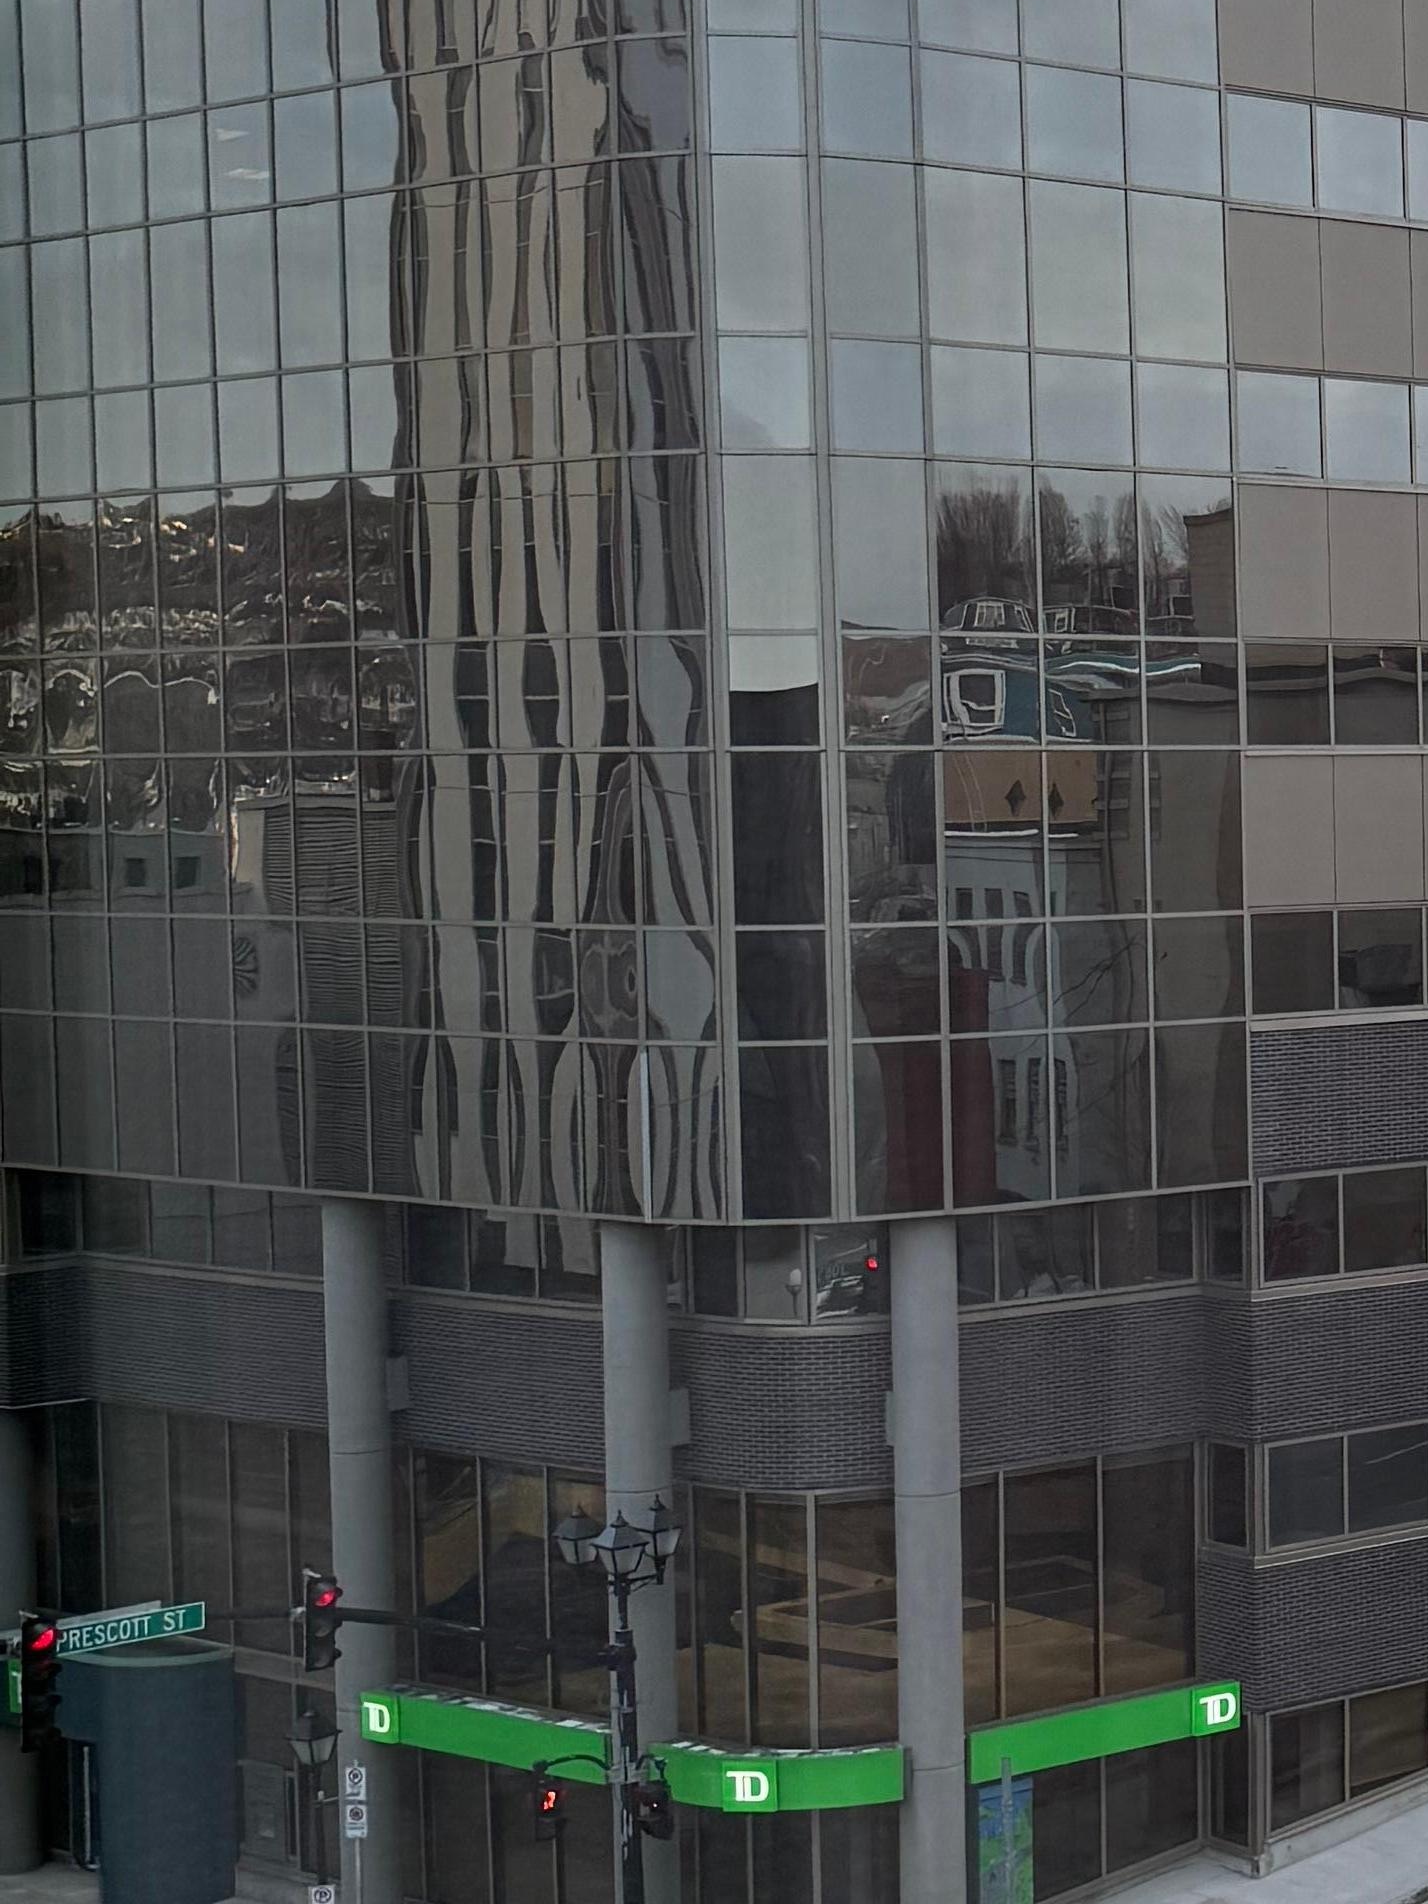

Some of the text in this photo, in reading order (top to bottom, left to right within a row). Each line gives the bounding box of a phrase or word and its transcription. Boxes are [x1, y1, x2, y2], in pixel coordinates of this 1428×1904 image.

[56, 1609, 187, 1653] PRESCOTT ST
[363, 1701, 391, 1733] TD
[1199, 1692, 1237, 1726] TD
[726, 1770, 769, 1802] TD
